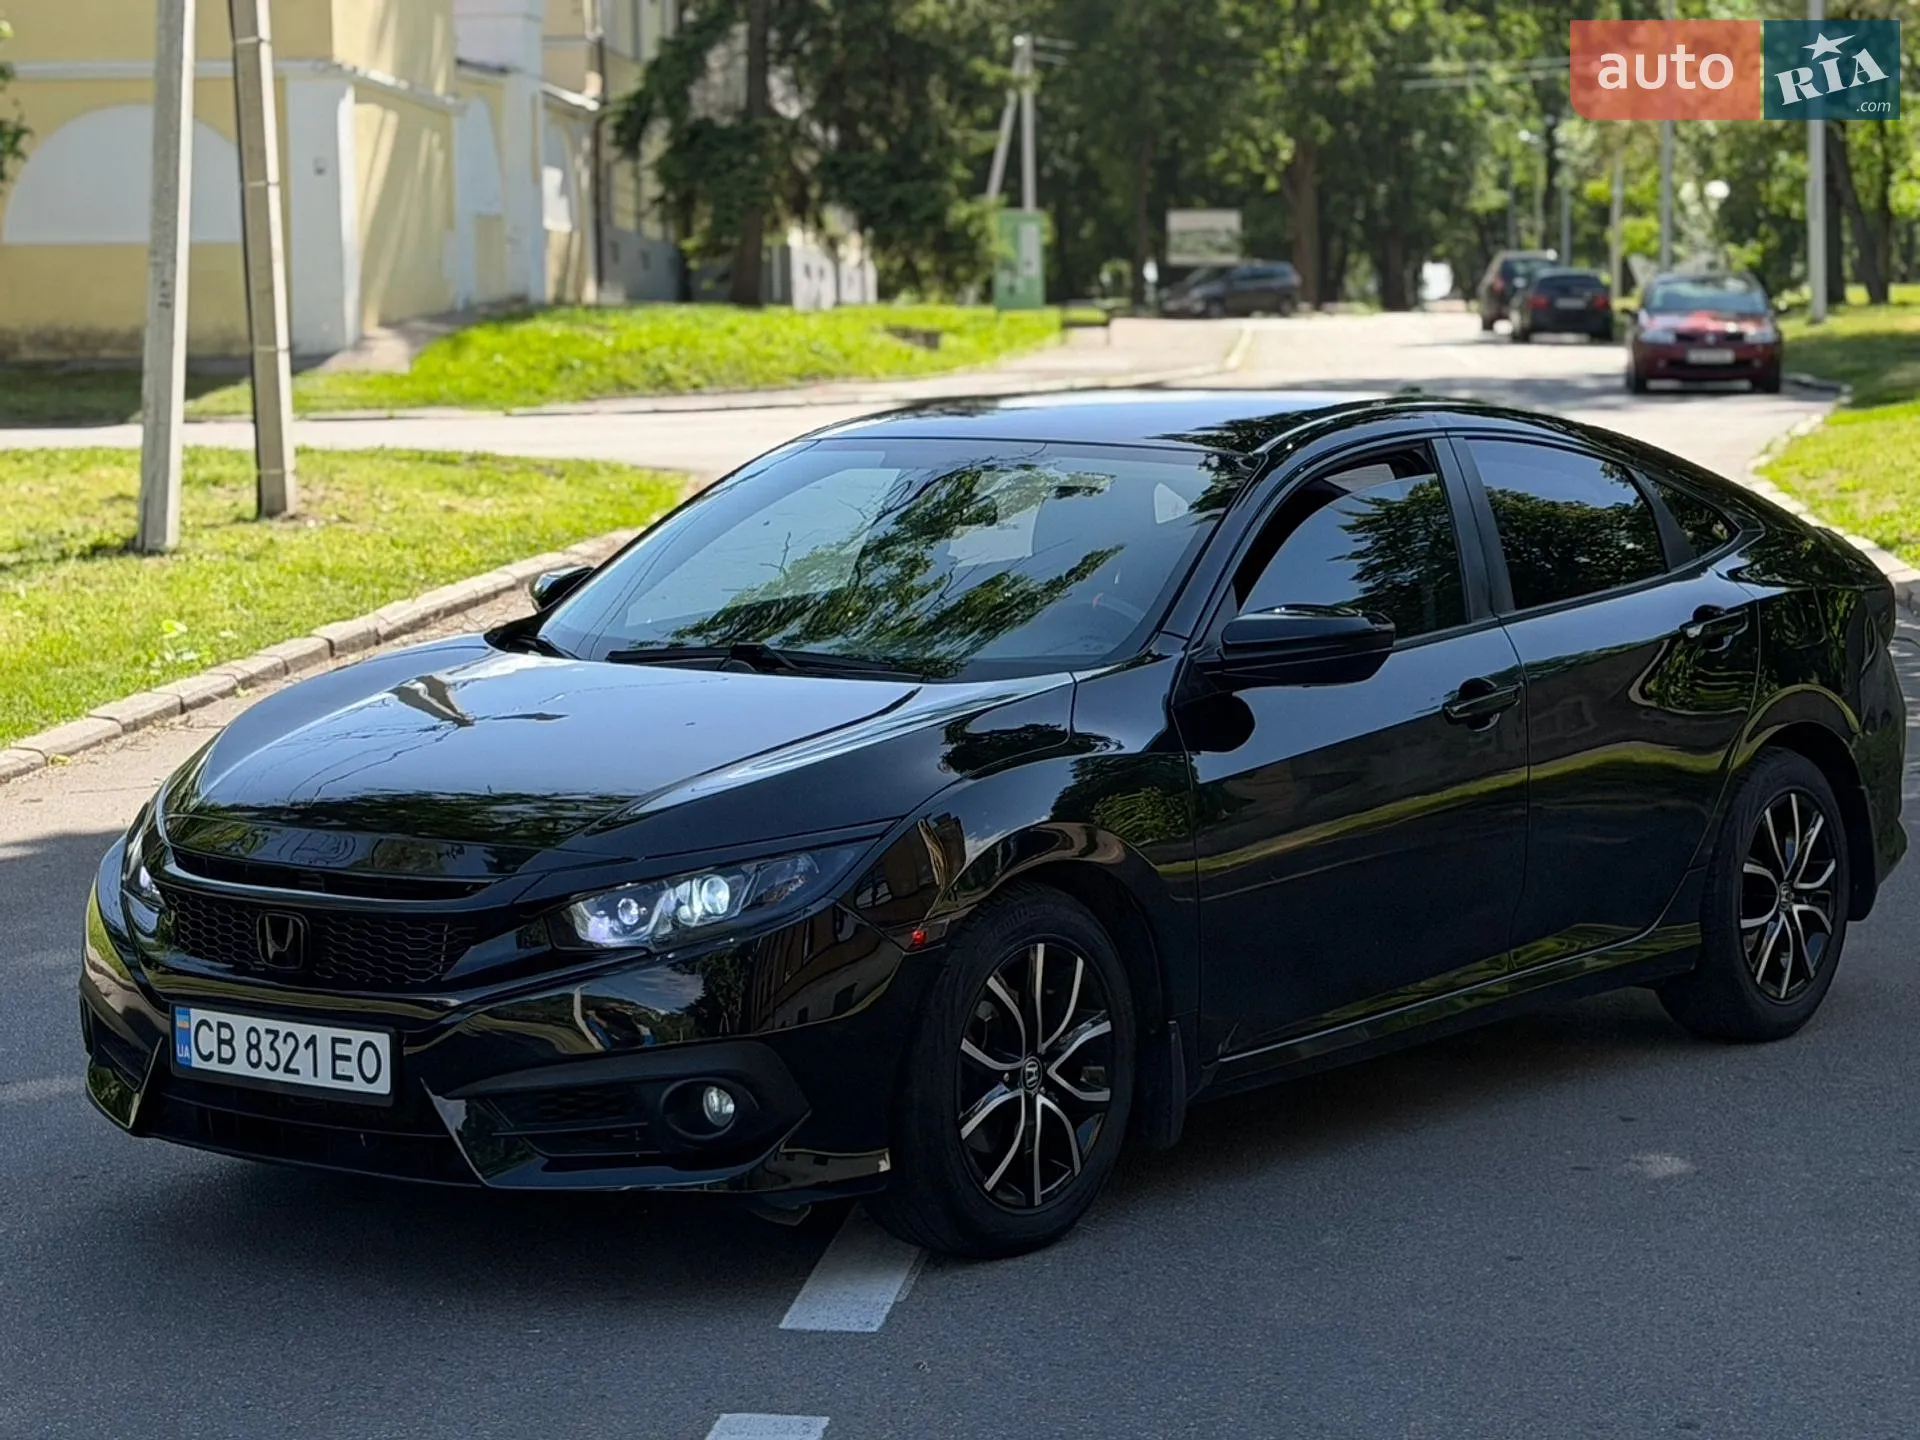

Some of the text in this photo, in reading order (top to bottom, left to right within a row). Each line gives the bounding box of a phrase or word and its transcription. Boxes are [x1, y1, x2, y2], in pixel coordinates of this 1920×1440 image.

[177, 1043, 191, 1058] UA
[193, 1018, 382, 1085] CB 8321 EO
